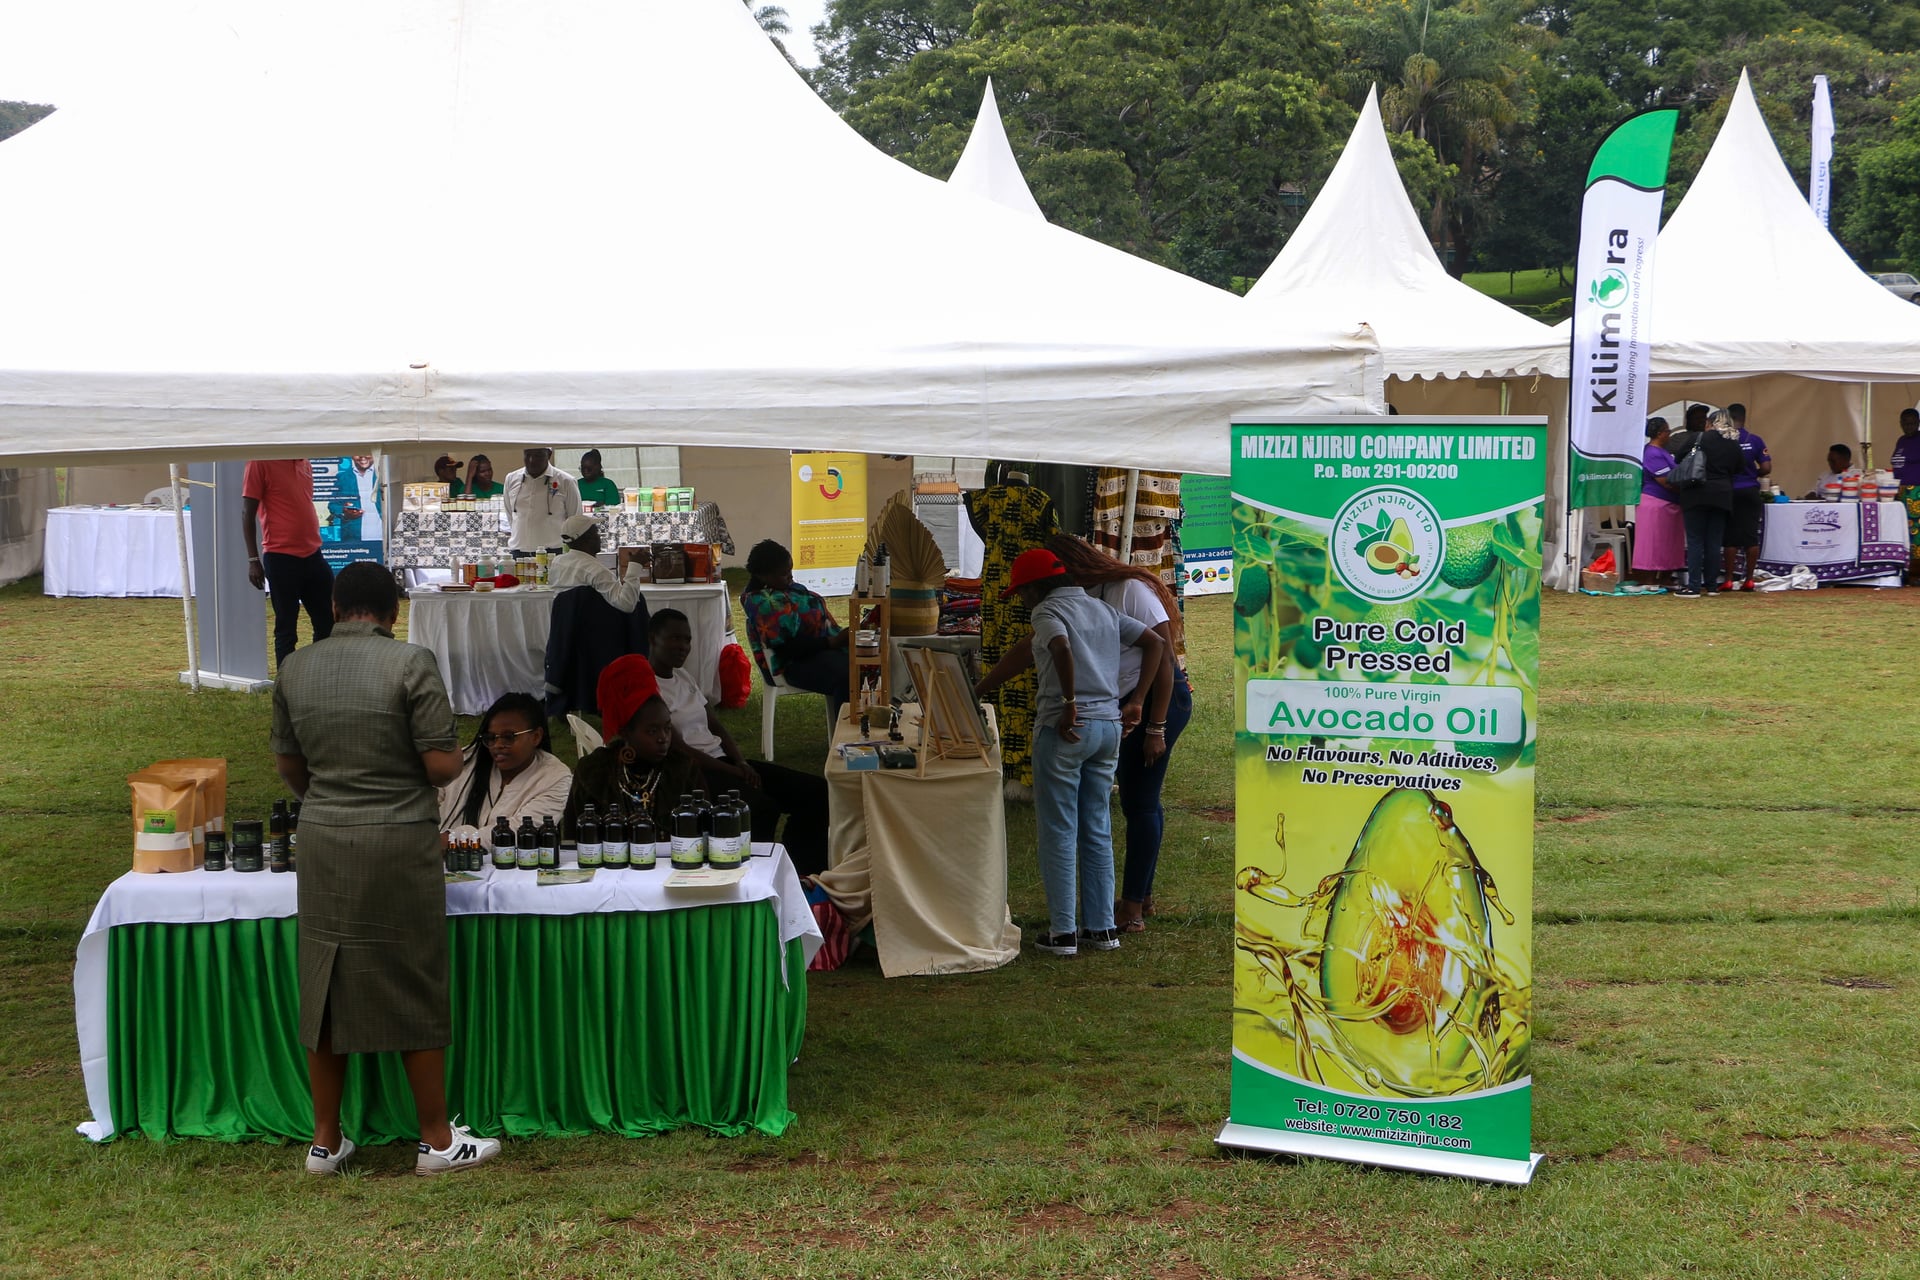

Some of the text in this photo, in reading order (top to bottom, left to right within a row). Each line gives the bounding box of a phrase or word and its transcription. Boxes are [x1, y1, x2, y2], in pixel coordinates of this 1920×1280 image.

[1625, 237, 1646, 406] Reimagining Innovation and Progress!
[1241, 435, 1536, 461] MIZIZI NJIRU COMPANY LIMITED
[1314, 464, 1458, 480] P.o. Box 291-00200
[1578, 472, 1633, 482] @kilimora.africa
[1341, 495, 1433, 533] MIZIZI NJIRU LTD
[1314, 617, 1465, 645] Pure Cold
[1326, 646, 1452, 673] Pressed
[1324, 686, 1441, 704] 100% Pure Virgin
[1268, 701, 1498, 736] Avocado Oil
[1267, 745, 1499, 773] No Flavours, No Aditives,
[1302, 768, 1462, 791] No Preservatives
[1293, 1098, 1463, 1131] Tel: 0720 750 182
[1284, 1116, 1472, 1150] website: www.mizizinjiru.com
